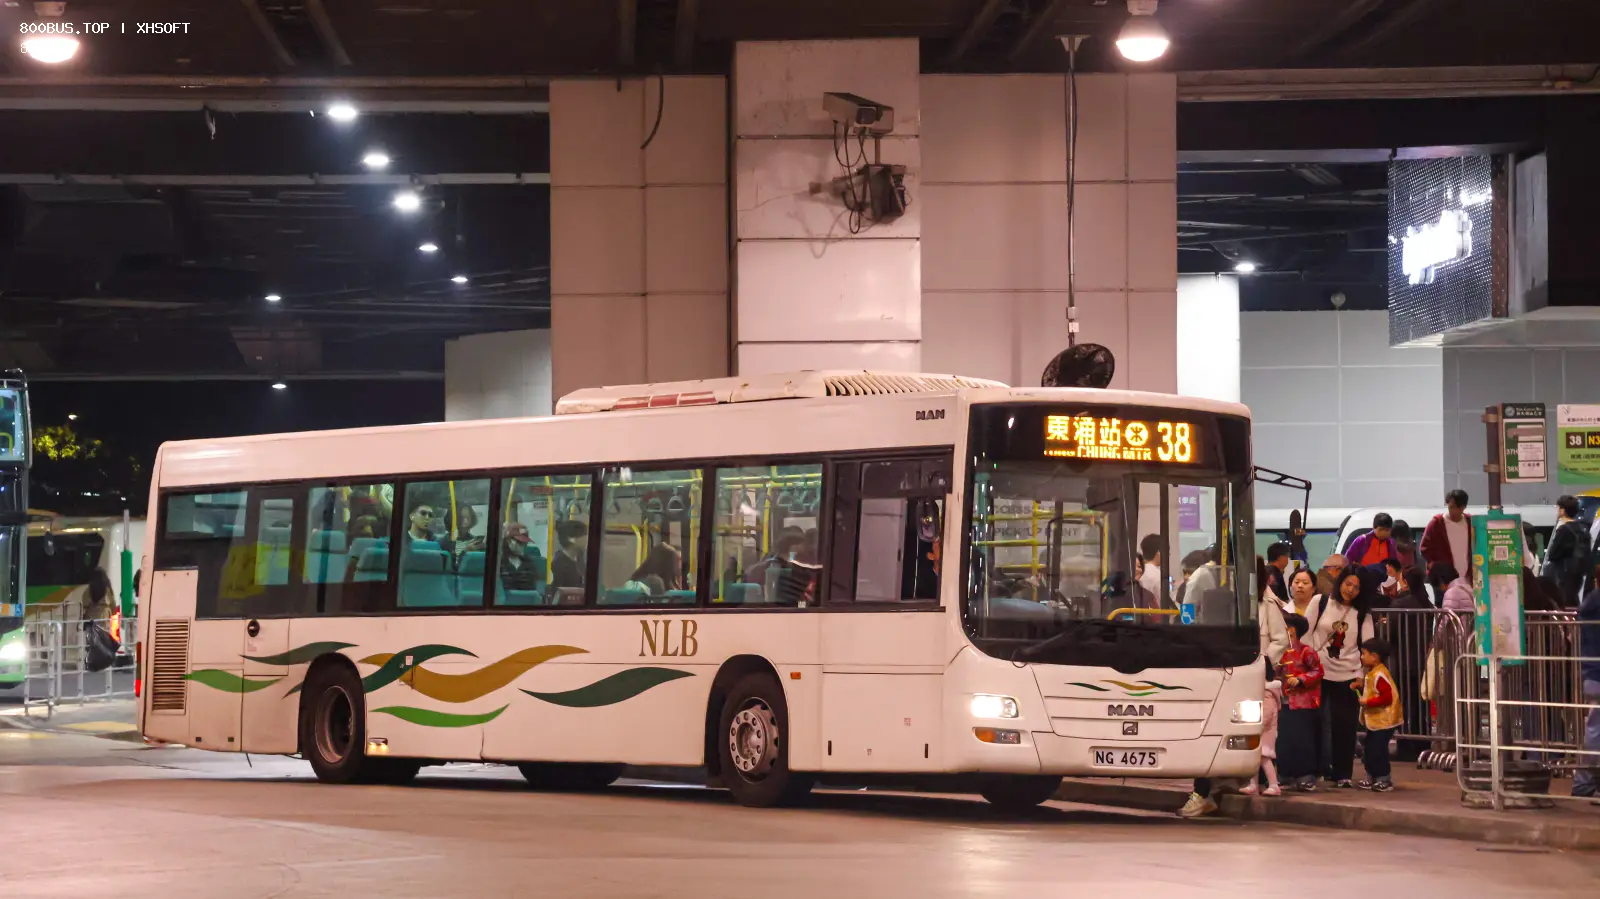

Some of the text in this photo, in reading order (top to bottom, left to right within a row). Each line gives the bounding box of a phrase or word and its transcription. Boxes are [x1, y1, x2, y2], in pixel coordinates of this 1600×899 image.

[915, 409, 946, 421] MAN
[1046, 415, 1191, 462] 東涌站 38
[1569, 435, 1582, 446] 38
[638, 619, 699, 657] NLB
[1107, 704, 1154, 717] MAN
[1095, 751, 1156, 765] NG 4675
